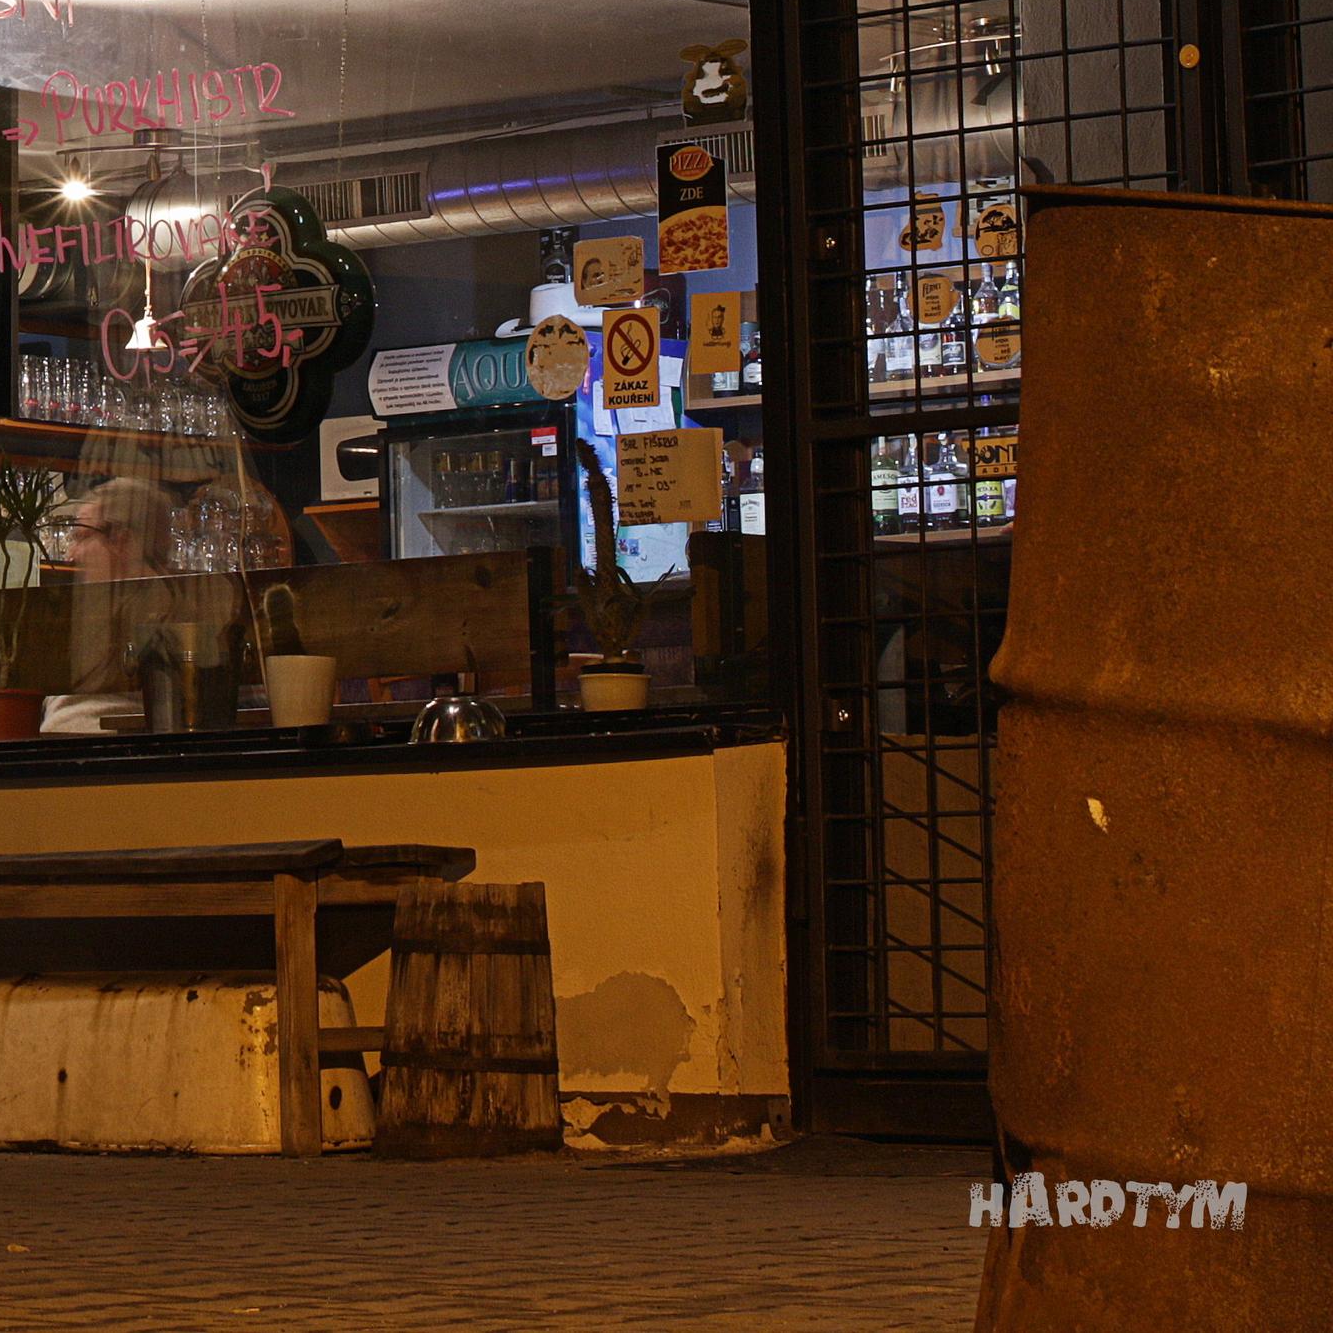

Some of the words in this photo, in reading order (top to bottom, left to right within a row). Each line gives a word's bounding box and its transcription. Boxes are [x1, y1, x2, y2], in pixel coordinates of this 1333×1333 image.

[669, 151, 715, 172] PIZZA
[679, 186, 704, 201] ZDE
[453, 350, 531, 400] AQU
[613, 378, 649, 392] ZÁKAZ
[608, 392, 655, 406] KOUŘENÍ
